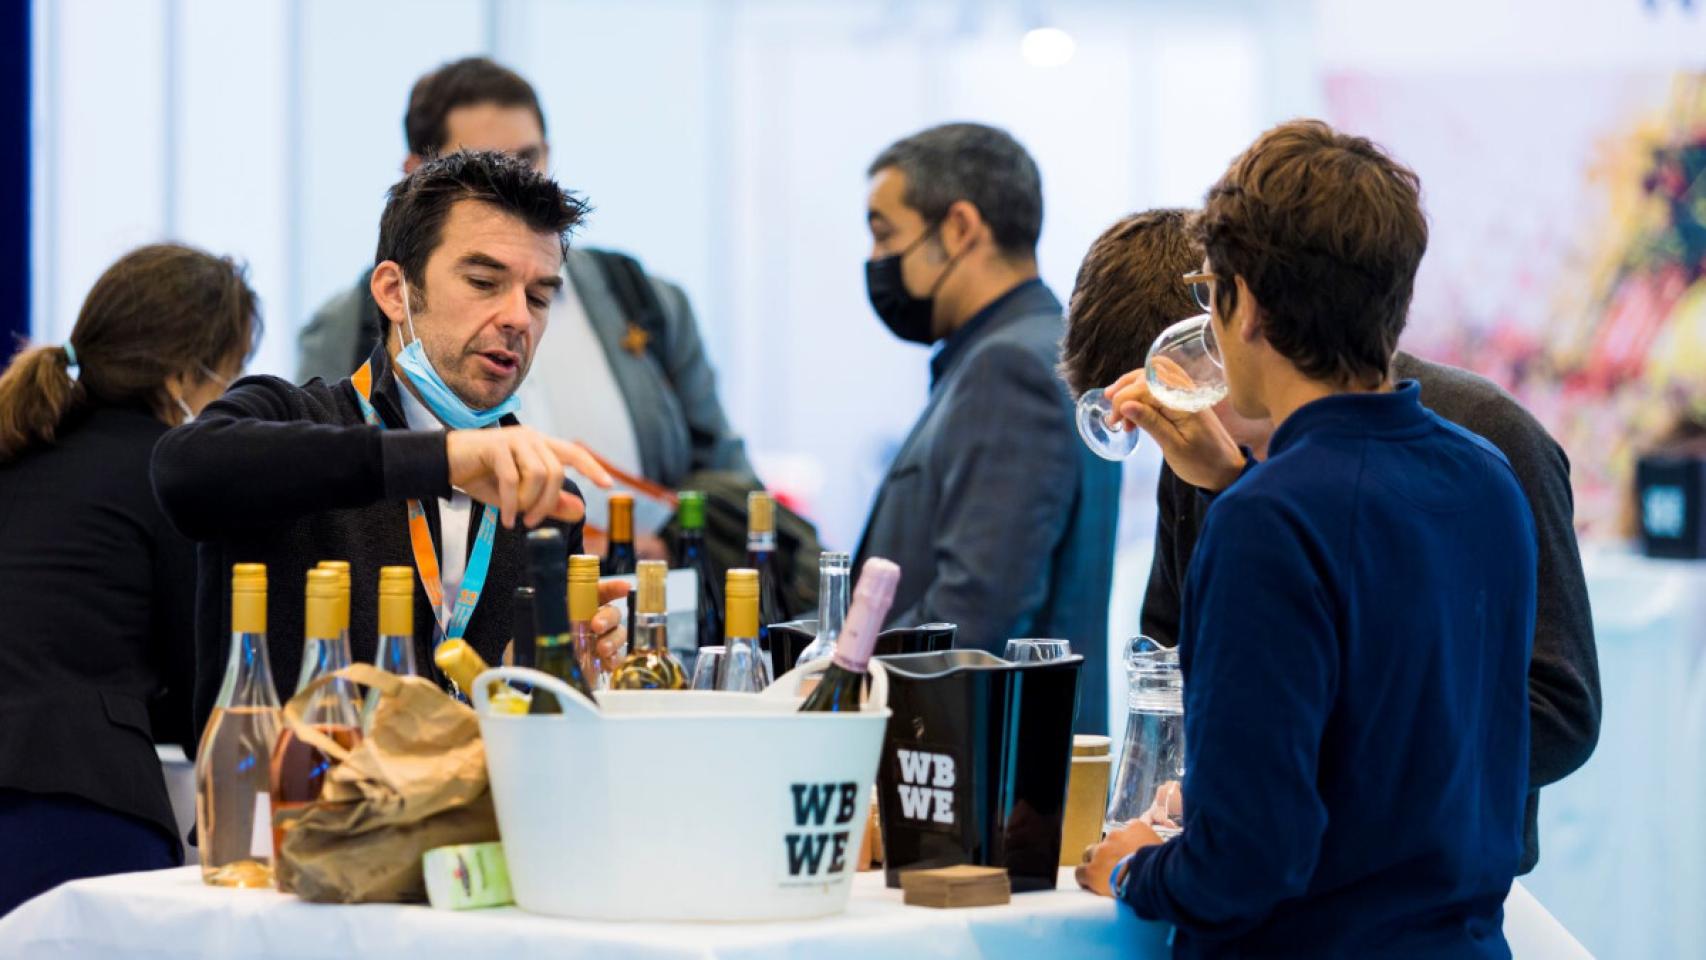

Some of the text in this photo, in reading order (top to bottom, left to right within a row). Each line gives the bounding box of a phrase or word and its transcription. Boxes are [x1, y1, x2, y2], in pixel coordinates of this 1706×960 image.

[896, 749, 955, 788] WB
[791, 782, 857, 825] WB
[897, 785, 955, 824] WE
[784, 832, 849, 875] WE
